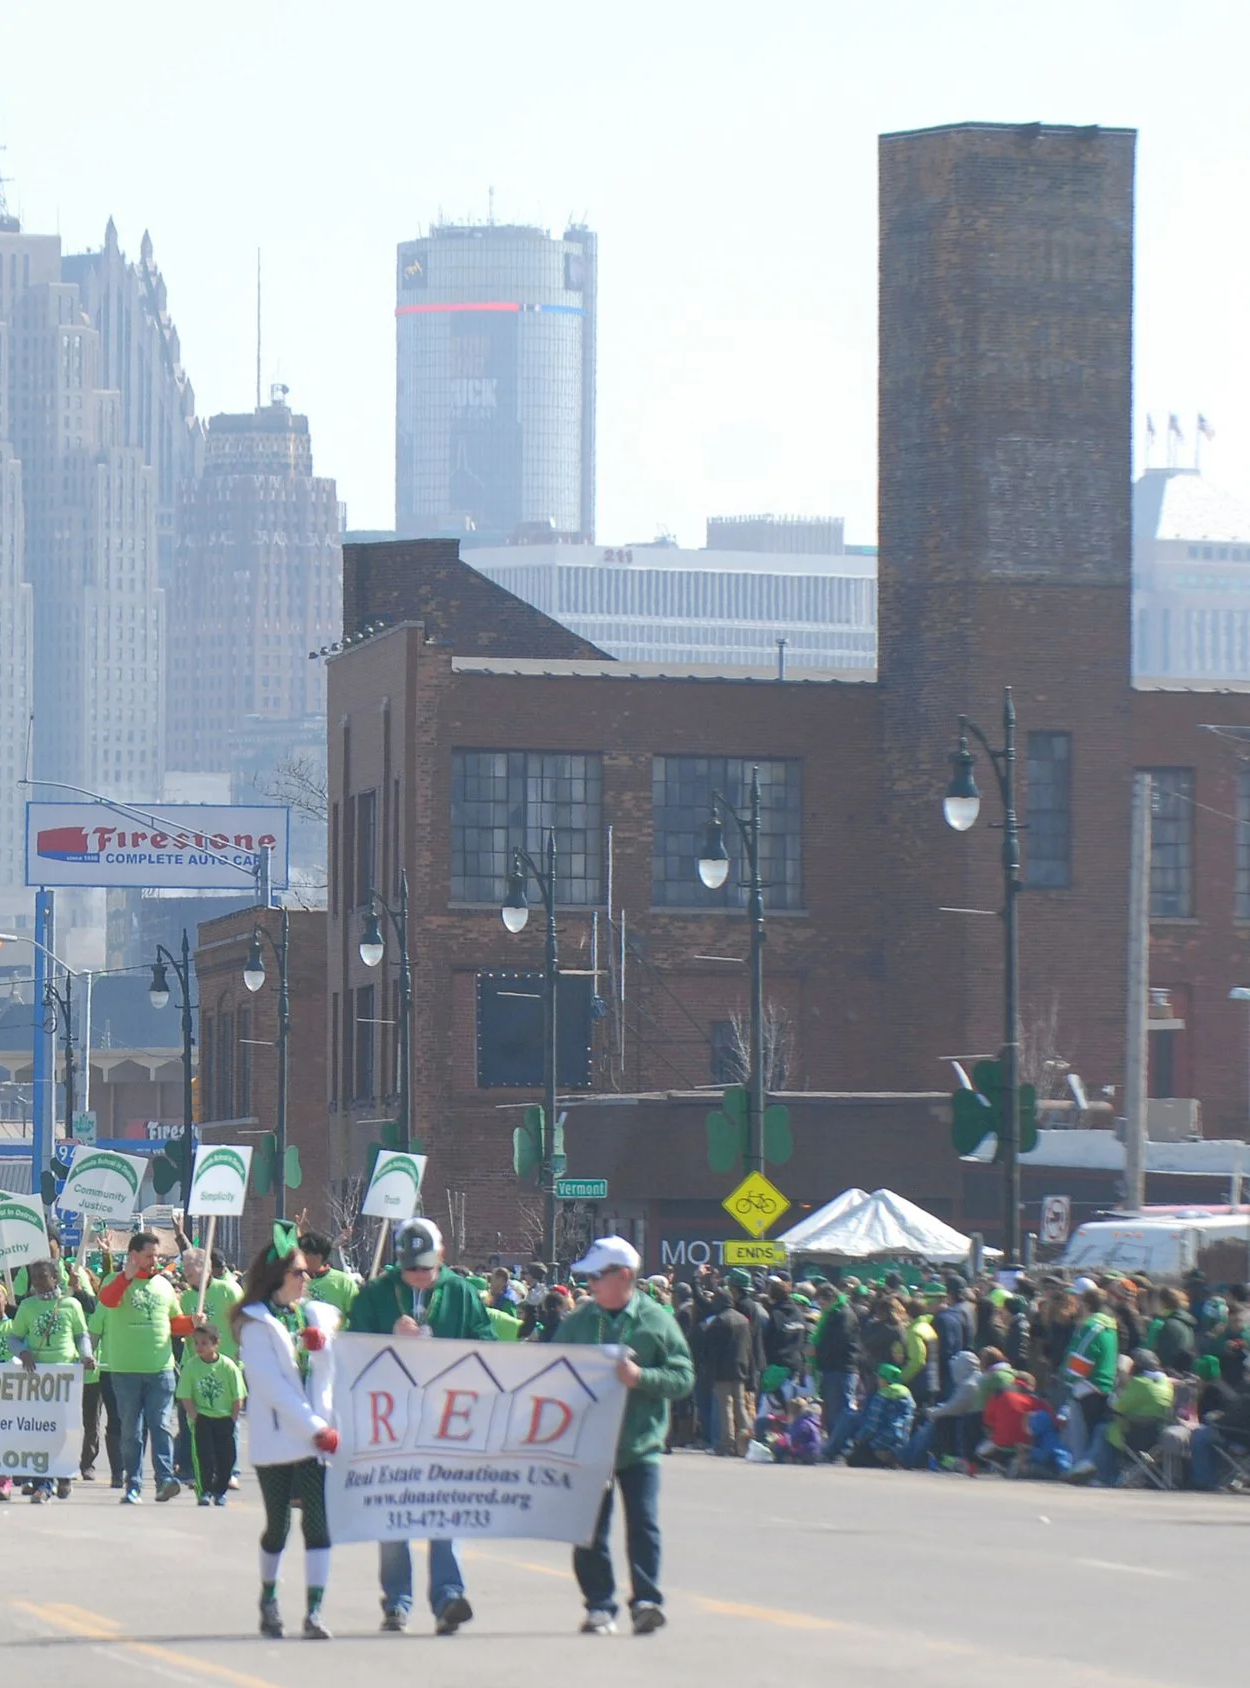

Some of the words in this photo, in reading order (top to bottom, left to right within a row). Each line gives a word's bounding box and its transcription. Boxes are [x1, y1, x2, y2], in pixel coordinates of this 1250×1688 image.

[92, 826, 276, 852] Firestone
[106, 853, 183, 865] COMPLETE
[188, 854, 228, 865] AUTO
[147, 1121, 200, 1140] Fires
[73, 1184, 127, 1203] Community
[558, 1182, 605, 1195] Vermont
[78, 1199, 113, 1213] Justice
[15, 1209, 38, 1223] Detroit
[736, 1247, 773, 1258] ENDS
[17, 1416, 56, 1432] Values
[345, 1466, 374, 1490] Real
[377, 1463, 422, 1486] Estate
[426, 1463, 520, 1484] Donations
[527, 1466, 574, 1490] USA
[363, 1488, 533, 1511] www.donatetored.org
[386, 1510, 491, 1529] 313-472-0733
